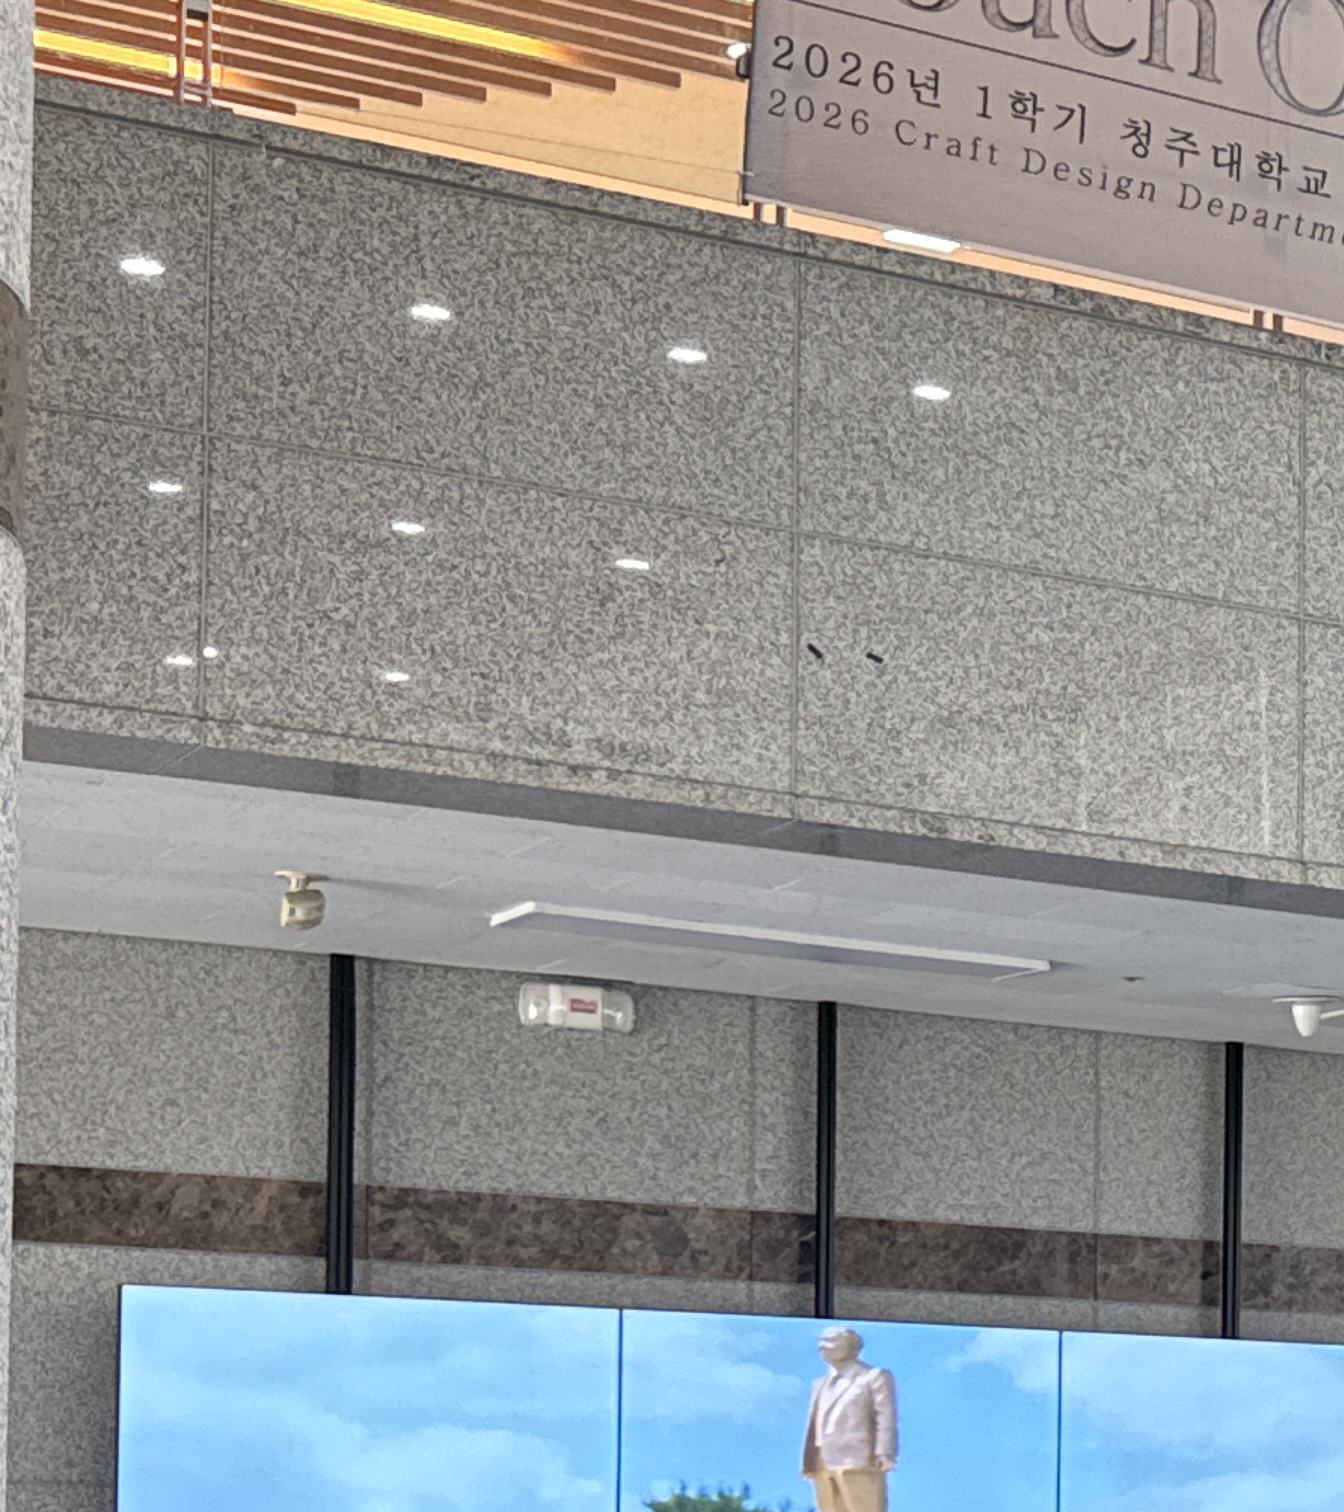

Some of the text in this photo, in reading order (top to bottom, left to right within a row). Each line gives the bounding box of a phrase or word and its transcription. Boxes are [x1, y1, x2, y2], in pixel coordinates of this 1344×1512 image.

[766, 88, 870, 137] 2026
[894, 118, 1000, 166] Craft
[1021, 147, 1157, 203] Design
[770, 34, 942, 109] 2026년
[975, 85, 1088, 145] 1학기
[1120, 117, 1332, 199] 청주대학교
